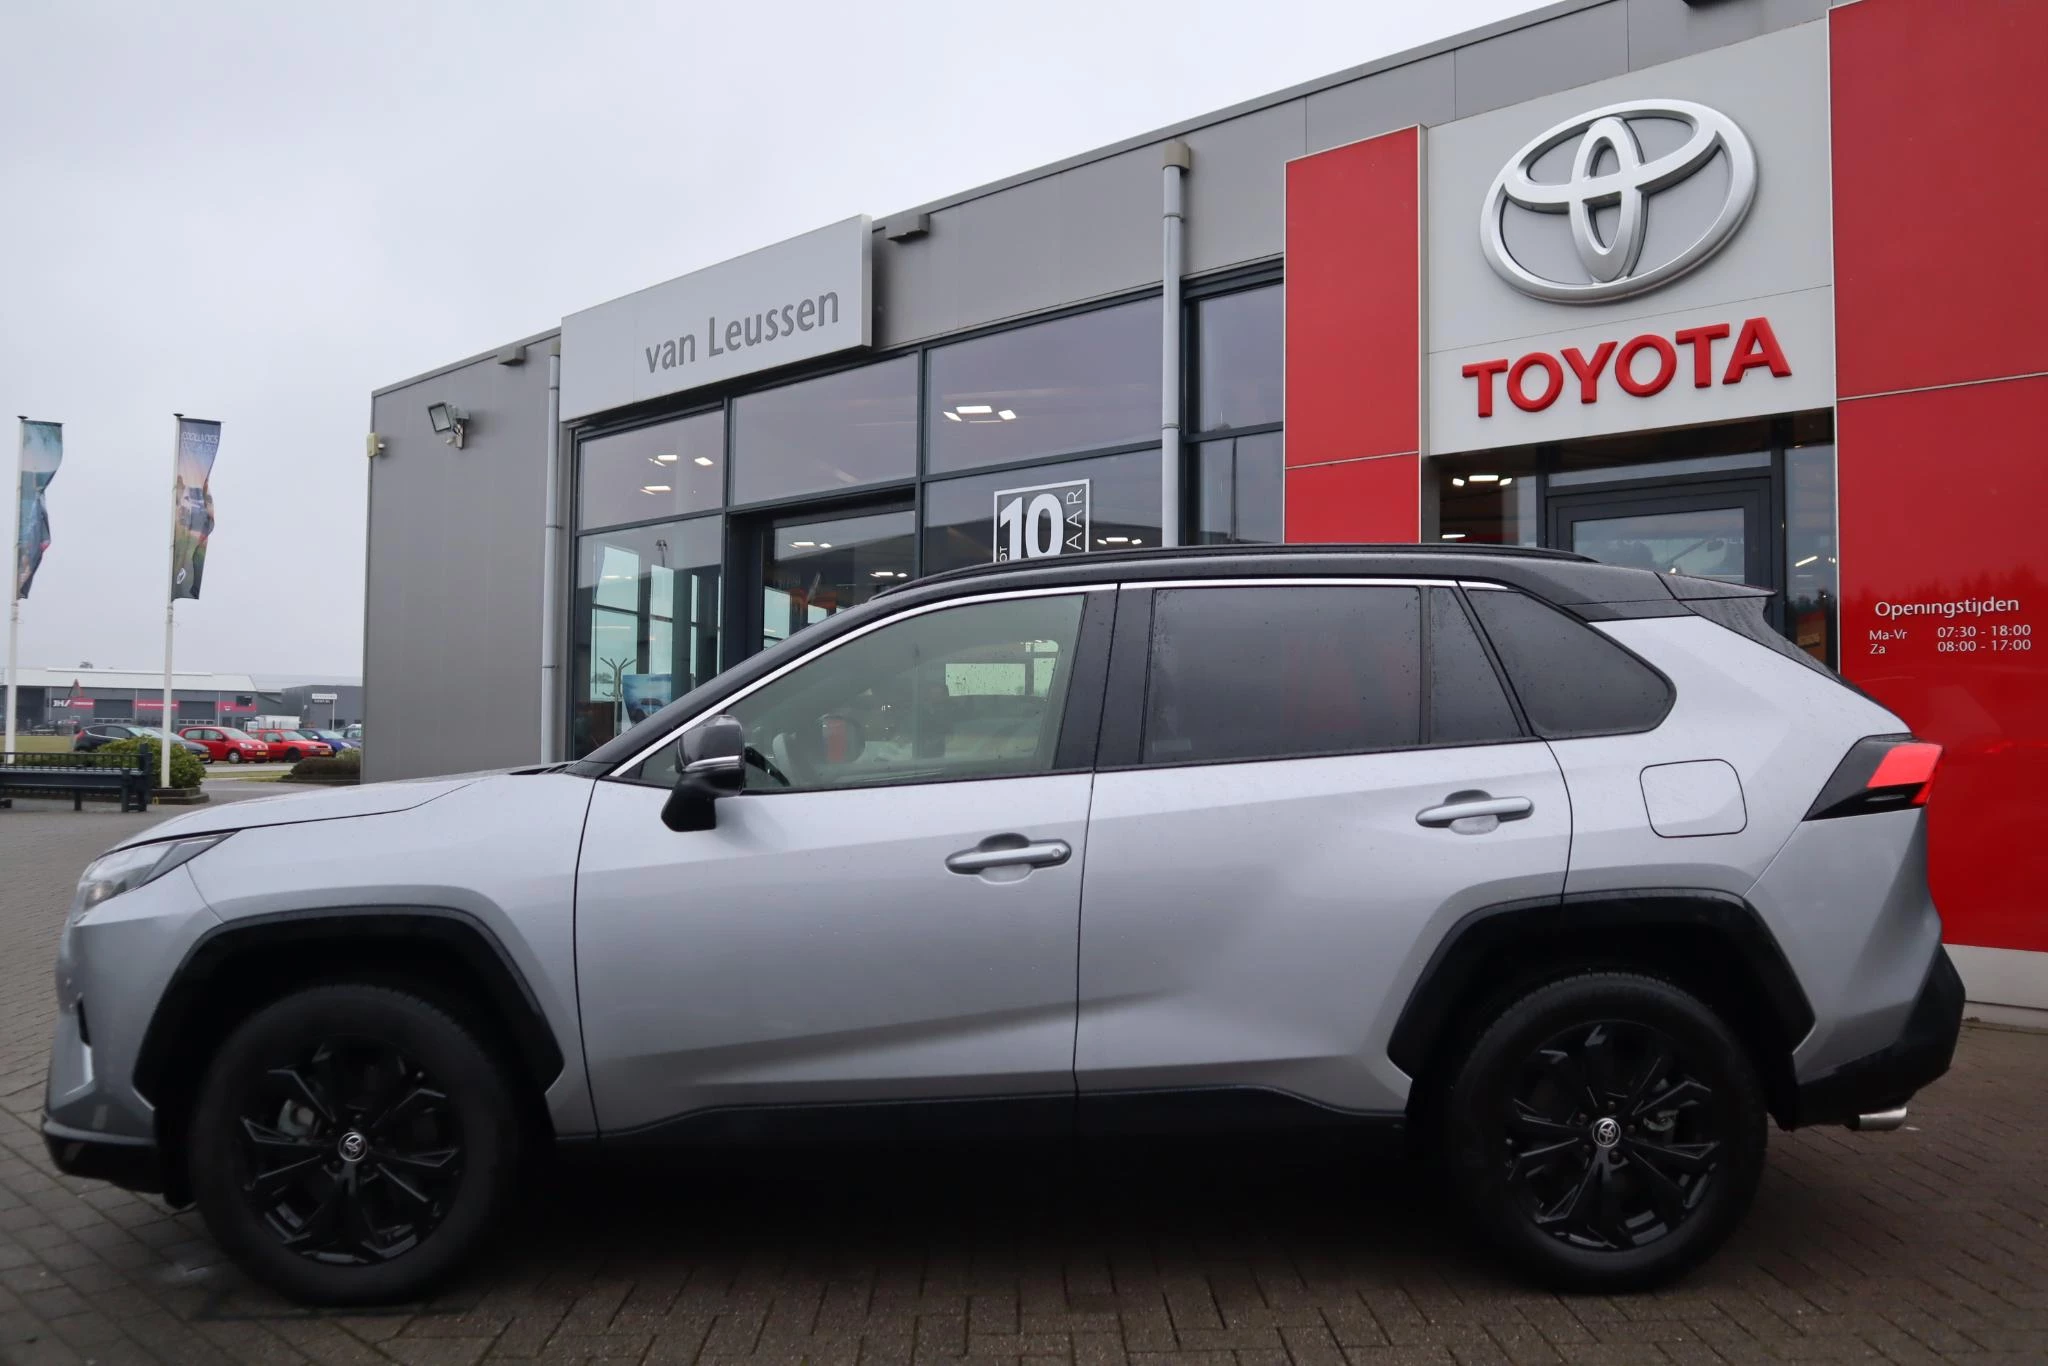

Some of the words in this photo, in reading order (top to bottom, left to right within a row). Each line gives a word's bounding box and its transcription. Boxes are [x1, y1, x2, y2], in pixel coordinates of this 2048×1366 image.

[646, 334, 695, 374] van
[709, 292, 839, 357] Leussen
[1462, 317, 1793, 418] TOYOTA
[1000, 493, 1064, 560] 10
[1066, 488, 1083, 550] AAR
[999, 546, 1008, 563] OT
[1875, 596, 2019, 620] Openingstijden
[1869, 629, 1908, 641] Ma-Vr
[1937, 626, 1977, 638] 07:30
[1992, 624, 2032, 637] 18:00
[1870, 643, 1886, 655] Za
[1937, 640, 1977, 652] 08:00
[1992, 639, 2032, 651] 17:00
